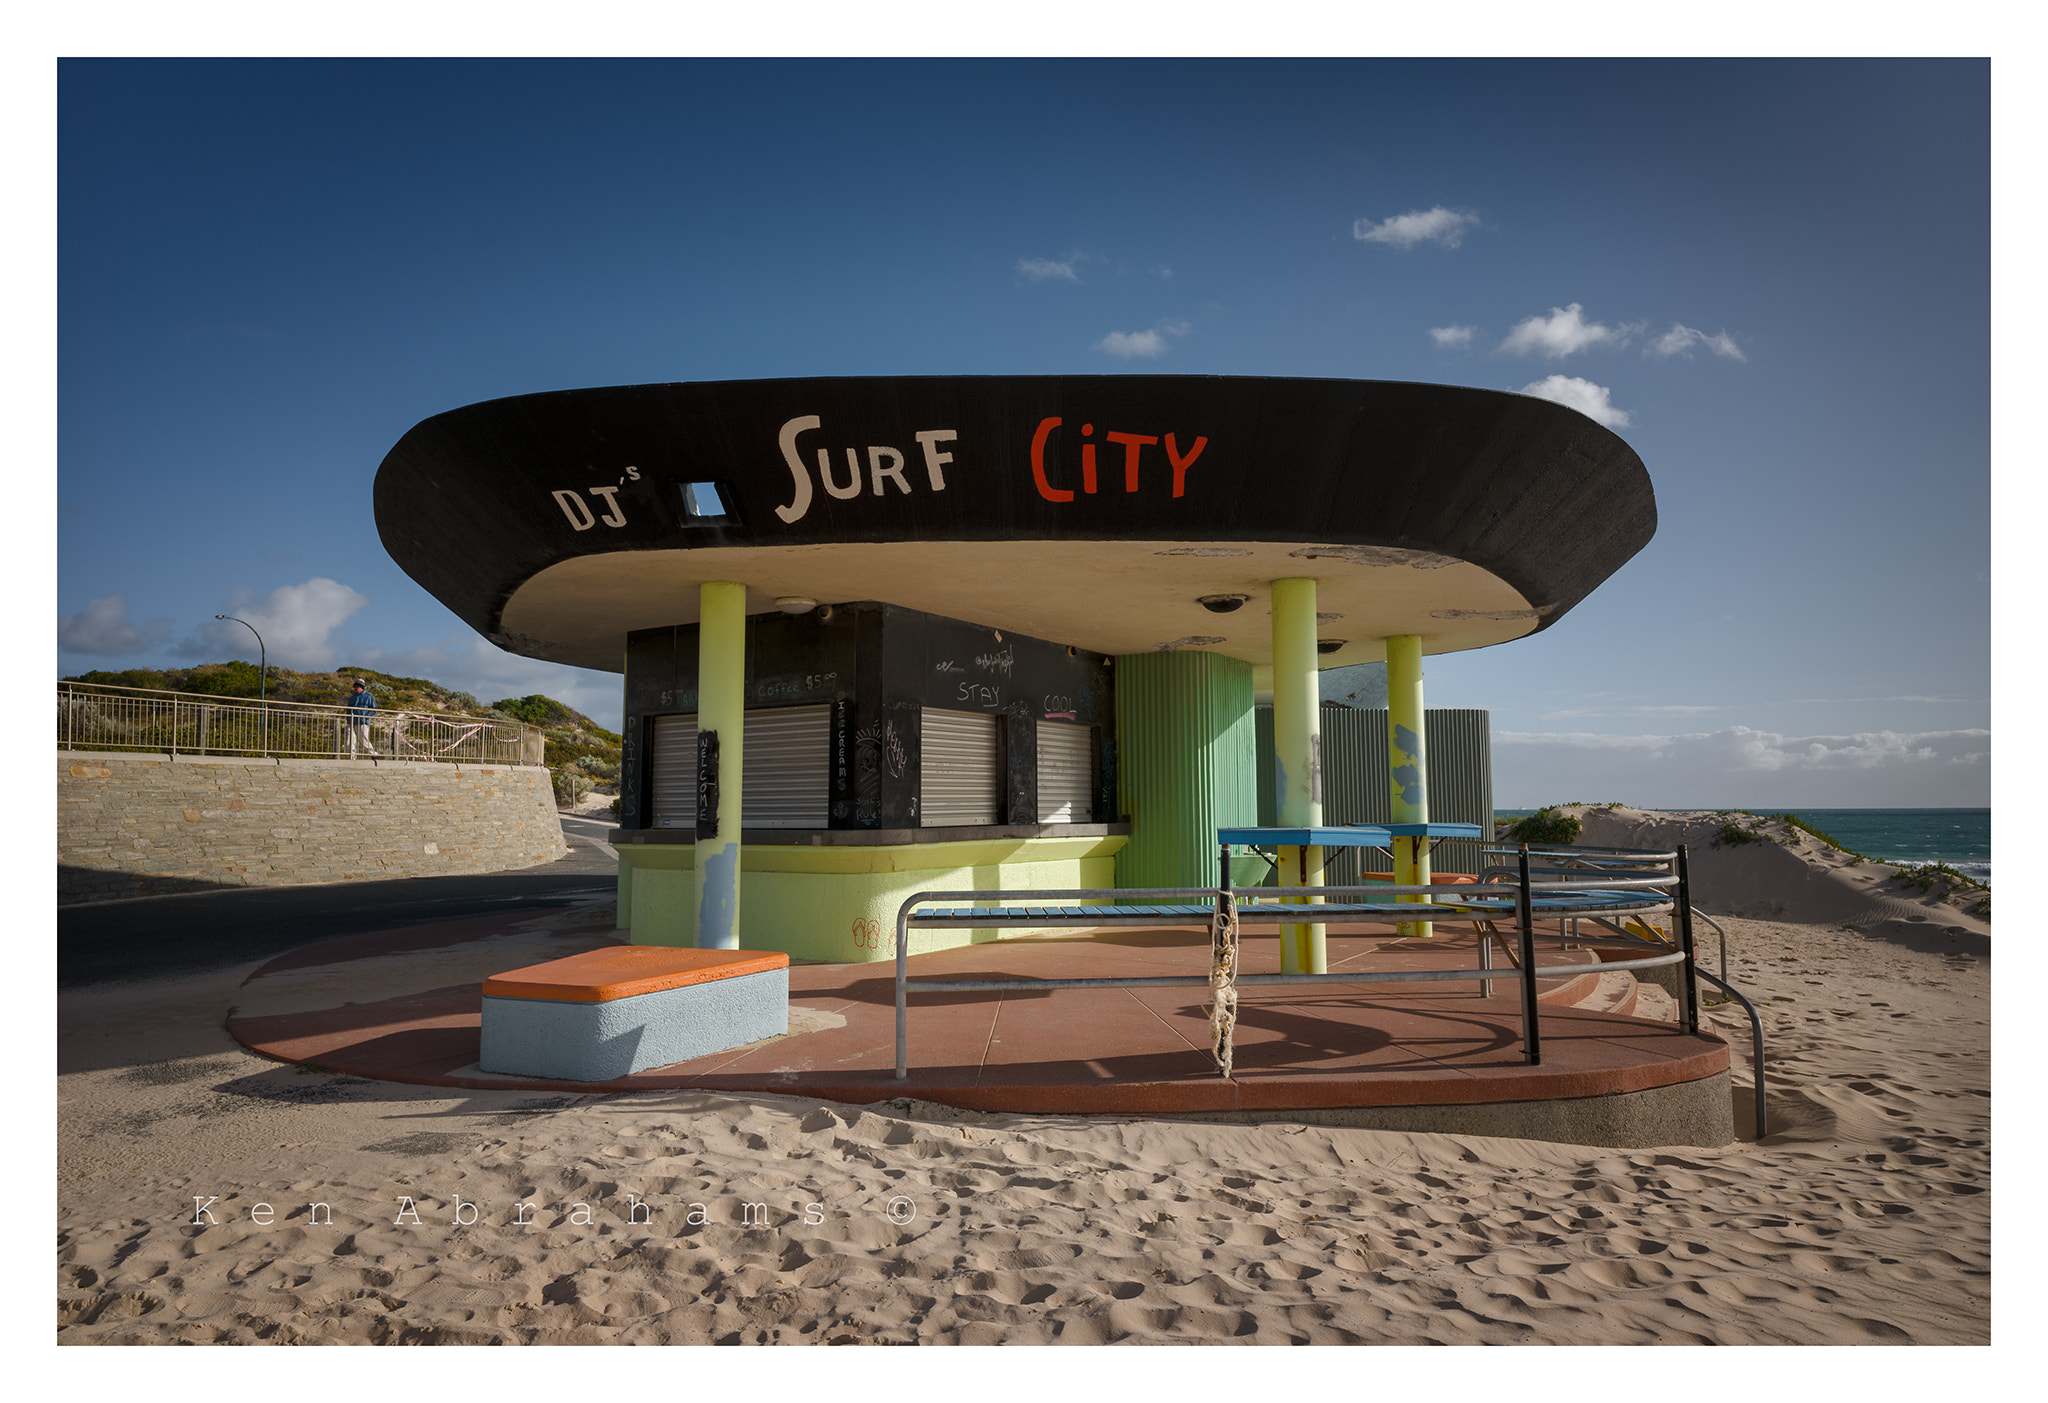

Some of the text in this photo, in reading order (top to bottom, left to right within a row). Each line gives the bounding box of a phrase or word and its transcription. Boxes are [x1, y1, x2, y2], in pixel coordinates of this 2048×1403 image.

[774, 414, 959, 525] SURF
[956, 681, 1000, 708] STAY
[1043, 694, 1077, 713] COOL
[625, 715, 638, 817] DRINKS
[698, 737, 709, 822] WELCOME
